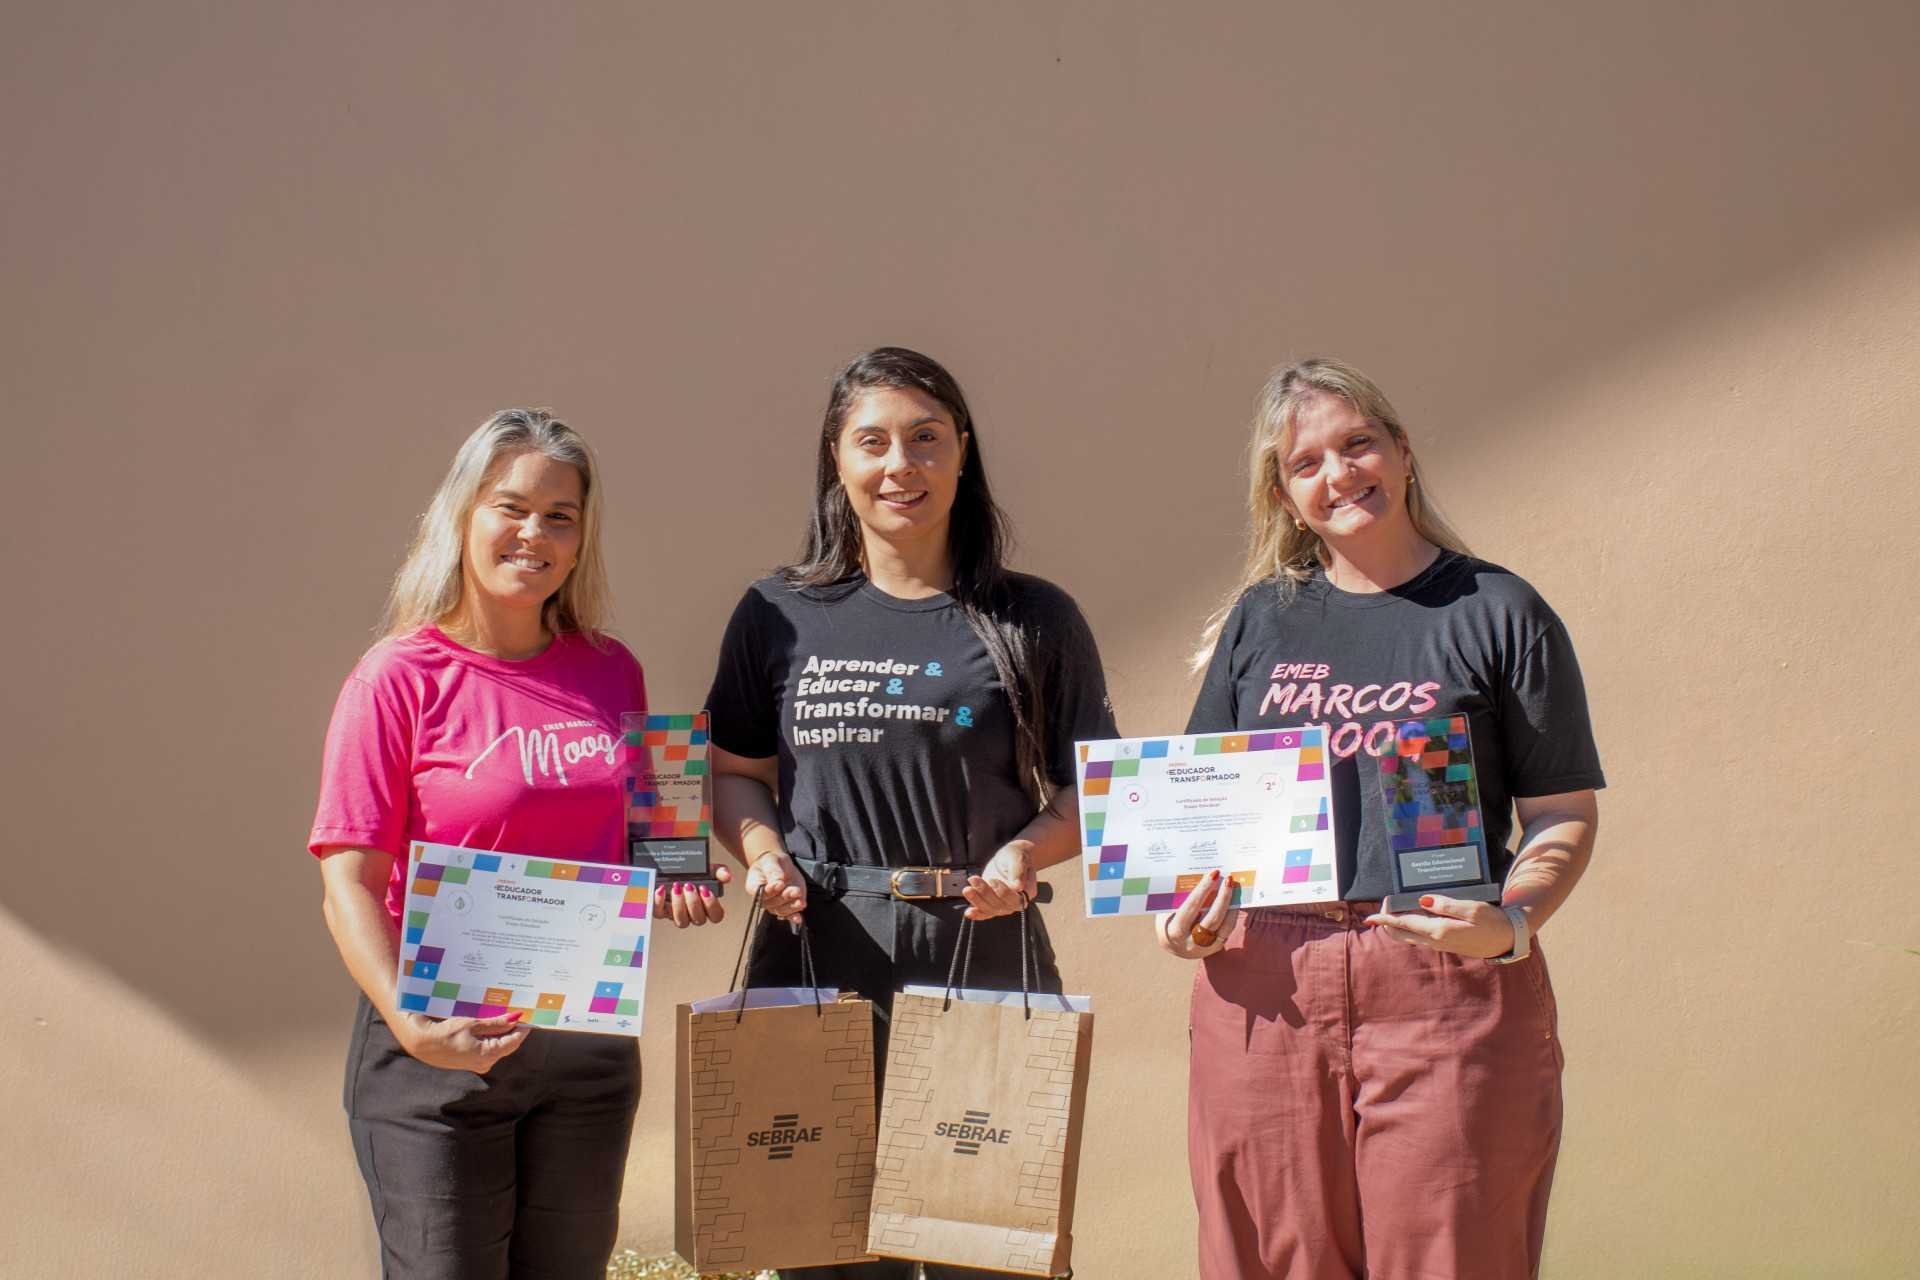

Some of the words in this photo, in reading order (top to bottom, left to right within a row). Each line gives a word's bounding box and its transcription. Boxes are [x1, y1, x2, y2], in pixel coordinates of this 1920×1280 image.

[802, 656, 920, 676] Aprender
[924, 662, 943, 677] &
[1270, 663, 1331, 680] EMEB
[797, 676, 880, 696] Educar
[885, 678, 904, 695] &
[1259, 681, 1441, 719] MARCOS
[794, 697, 950, 722] Transformar
[955, 706, 973, 727] &
[793, 721, 884, 748] Inspirar
[465, 726, 625, 786] Moog
[1169, 766, 1216, 776] EDUCADOR
[1170, 773, 1240, 784] TRANSFORMADOR
[495, 884, 543, 896] EDUCADOR
[496, 893, 566, 905] TRANSFORMADOR
[746, 1126, 823, 1147] SEBRAE
[934, 1121, 1012, 1145] SEBRAE
